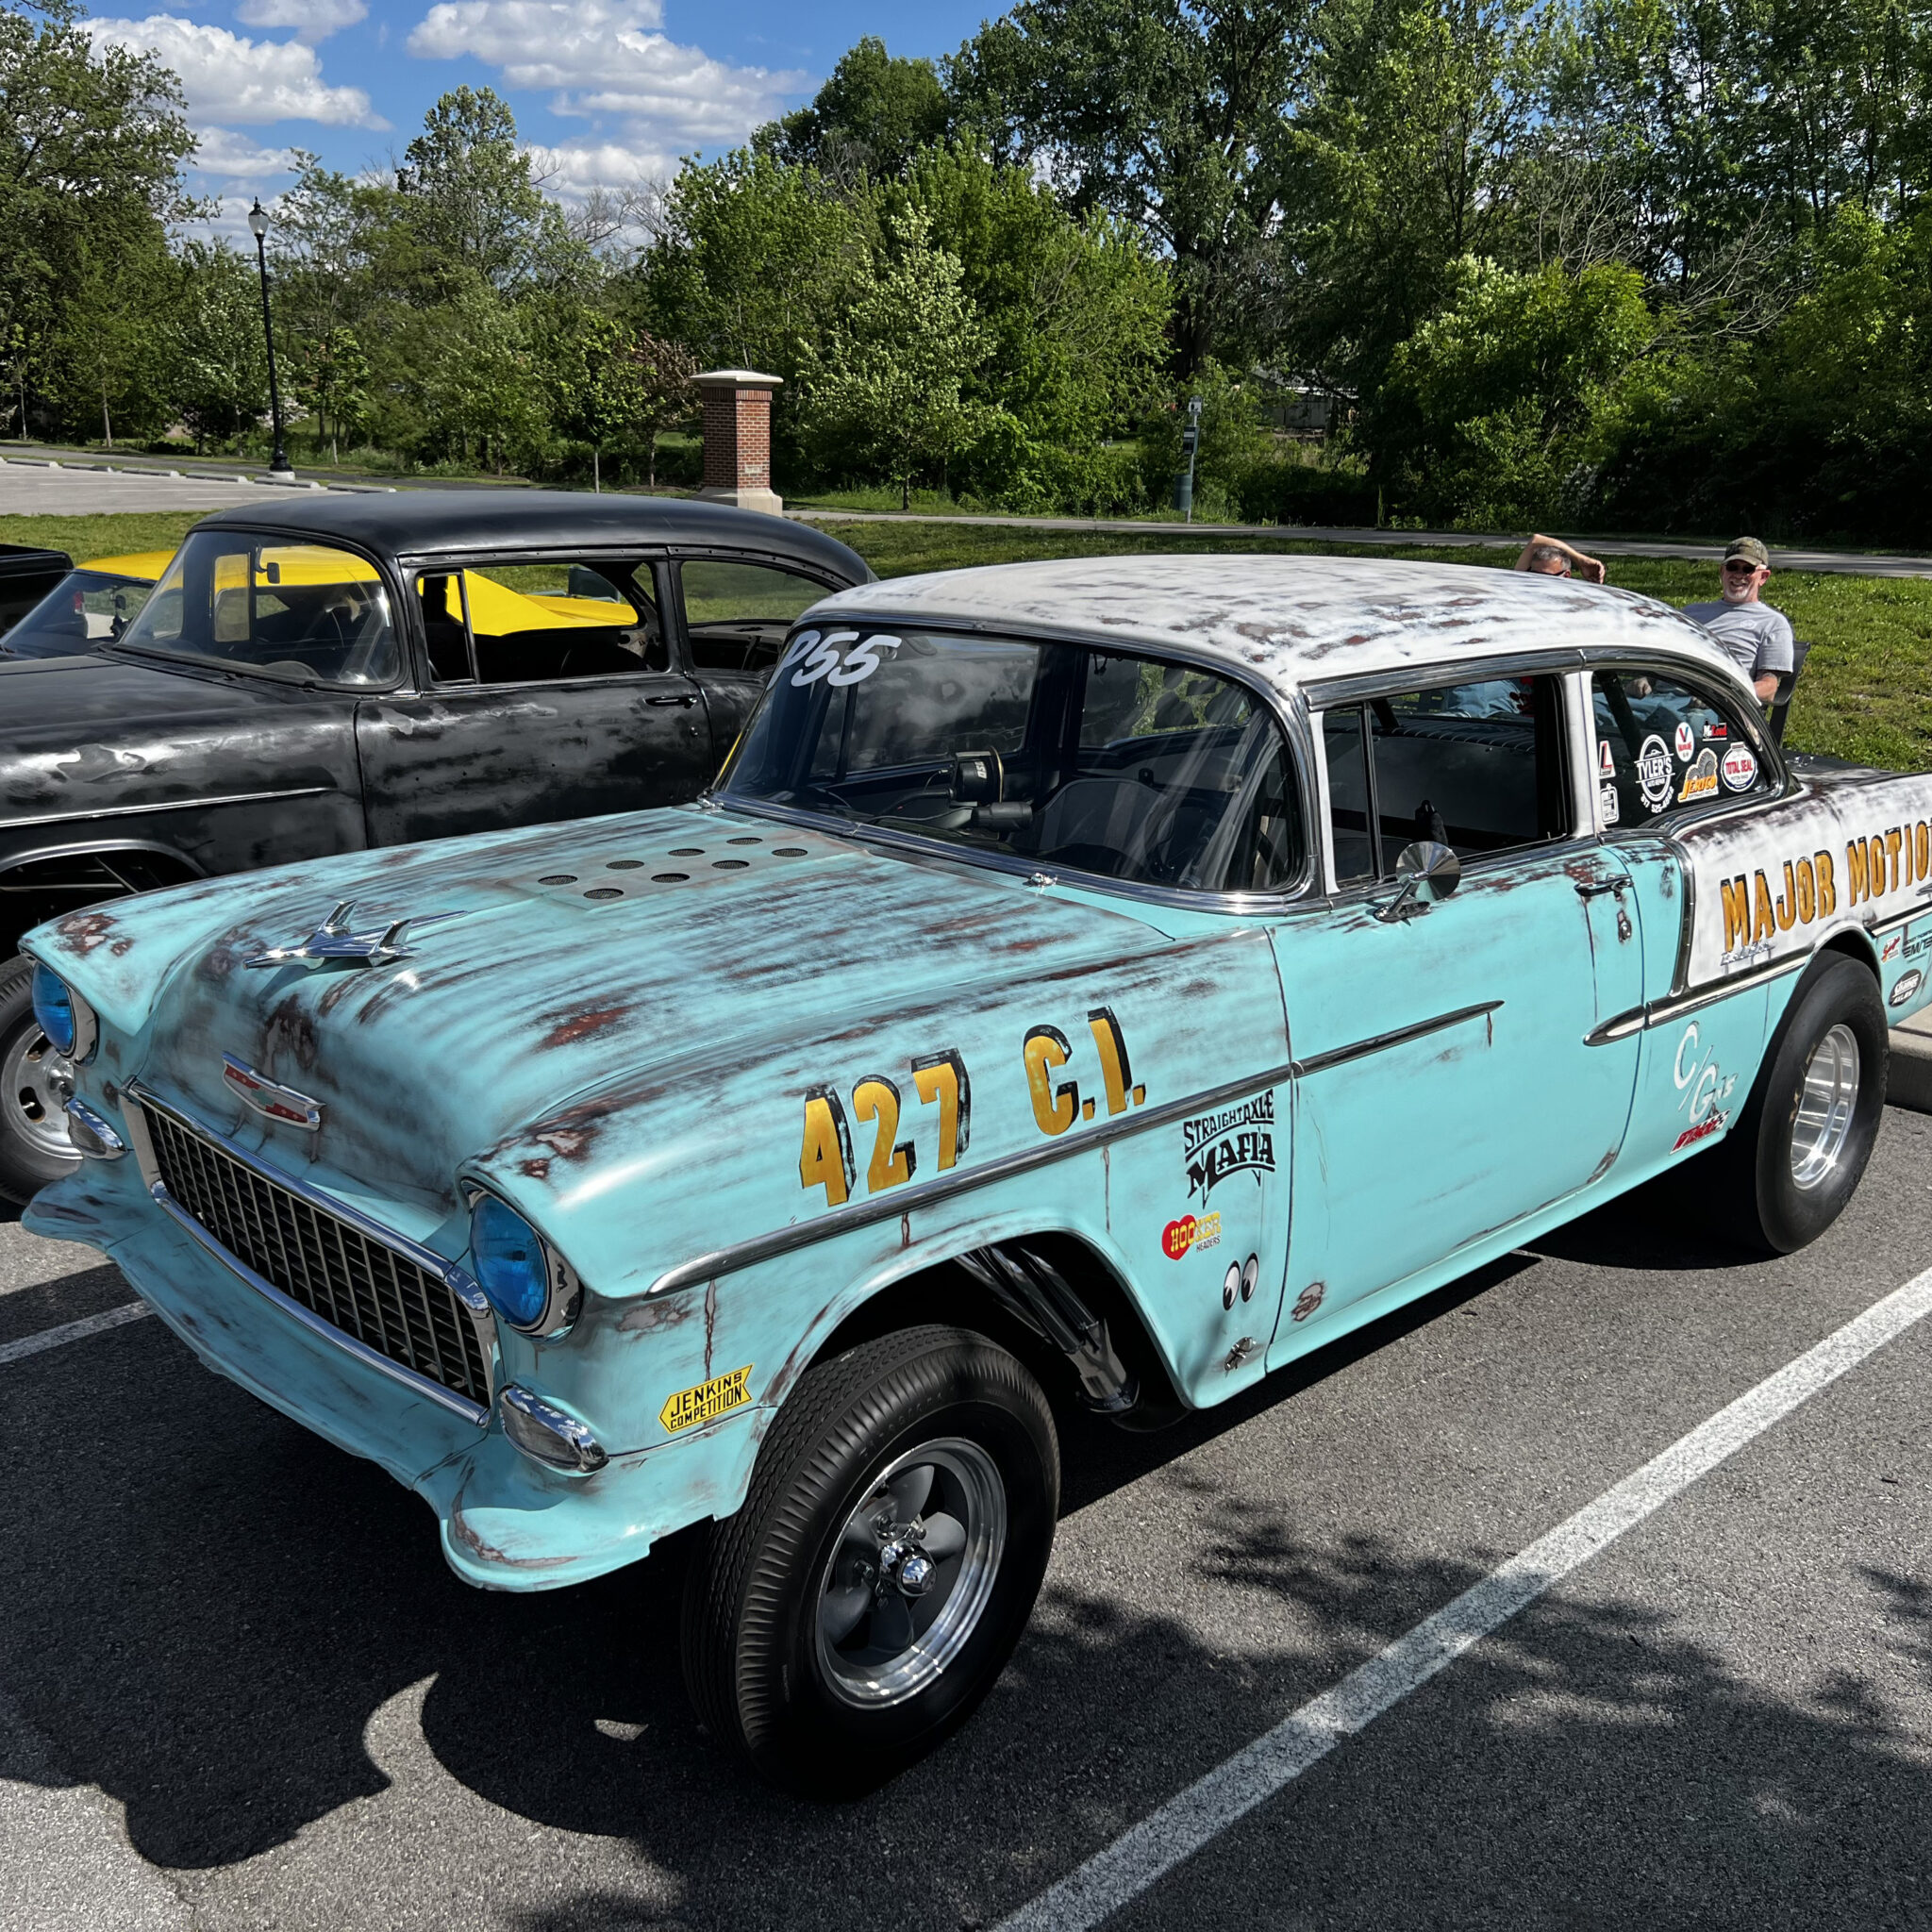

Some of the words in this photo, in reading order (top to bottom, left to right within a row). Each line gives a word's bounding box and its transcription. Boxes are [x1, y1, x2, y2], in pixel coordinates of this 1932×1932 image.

[1637, 757, 1673, 780] TYLER'S
[1679, 774, 1717, 800] JERICO
[1725, 761, 1740, 774] TOTAL
[1741, 758, 1754, 773] SEAL
[1720, 850, 1837, 953] MAJOR
[1846, 818, 1932, 908] MOTIO
[799, 1047, 971, 1208] 427
[1023, 1006, 1145, 1135] C.I.
[1186, 1131, 1275, 1199] MAFIA
[1171, 1212, 1221, 1253] HOOKER
[1196, 1236, 1221, 1253] HEADERS
[670, 1383, 742, 1429] COMPETITION
[671, 1372, 741, 1418] JENKINS
